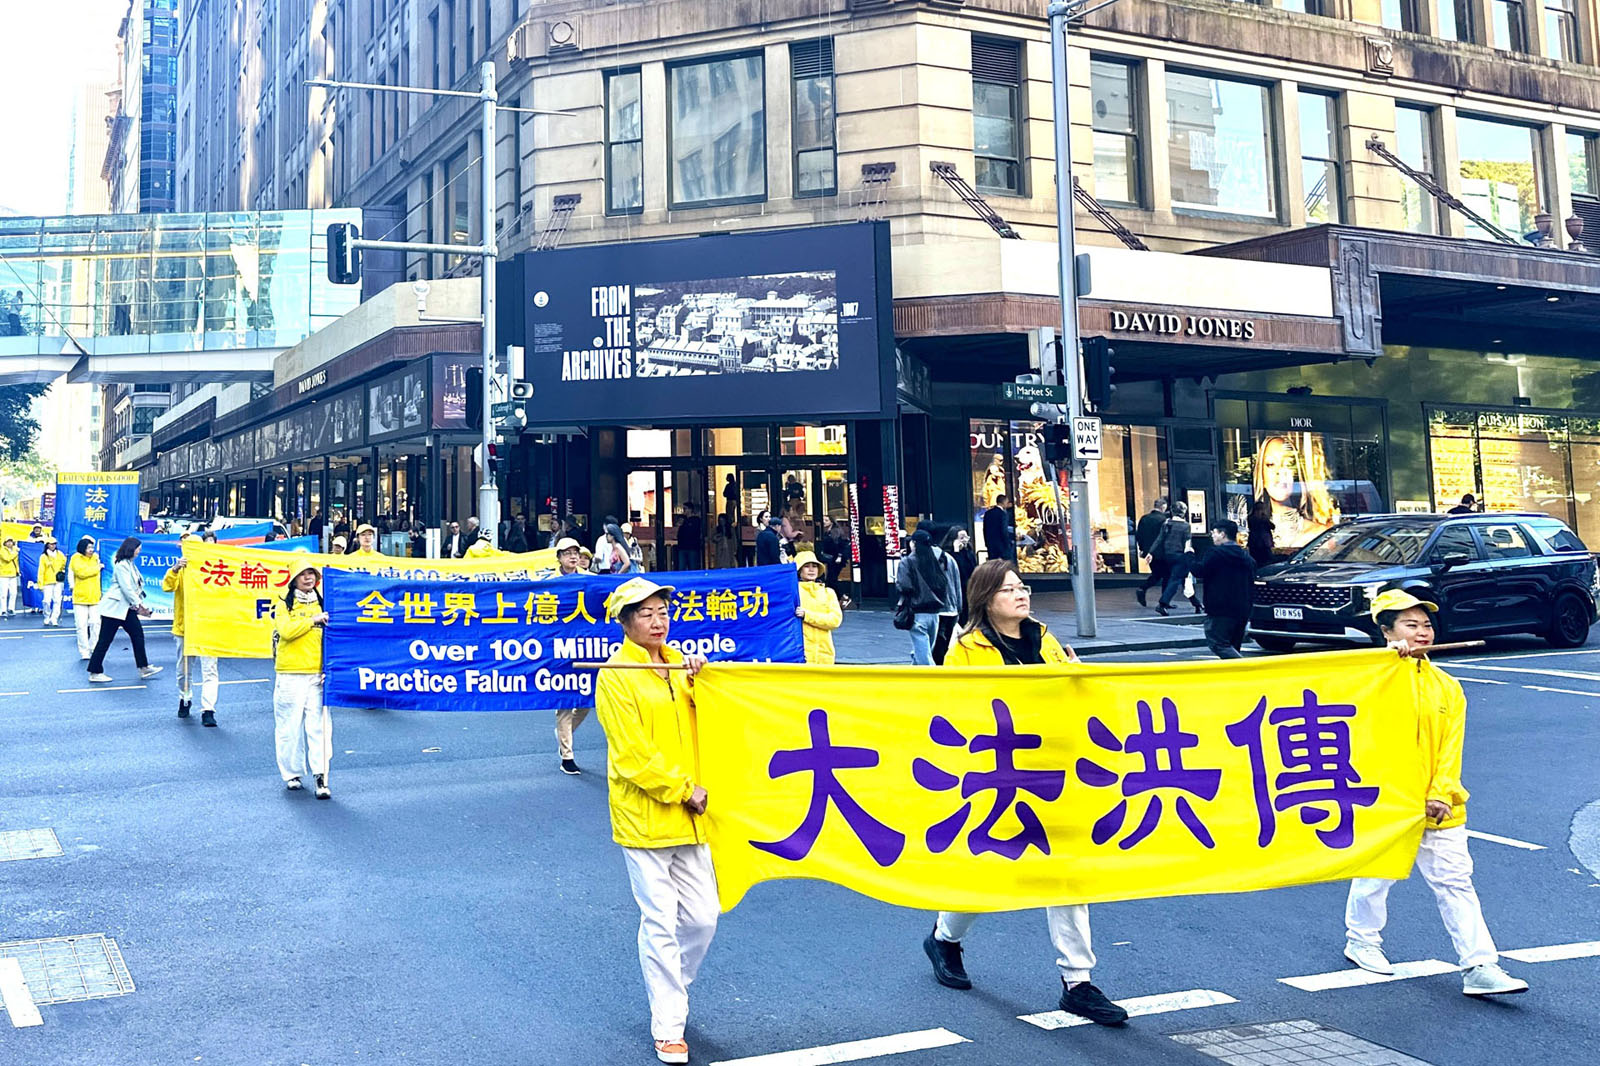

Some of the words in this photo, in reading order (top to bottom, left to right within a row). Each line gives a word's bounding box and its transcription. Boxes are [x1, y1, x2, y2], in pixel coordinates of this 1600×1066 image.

[591, 285, 630, 317] FROM
[605, 317, 631, 347] THE
[1113, 311, 1182, 333] DAVID
[1188, 316, 1255, 339] JONES
[561, 348, 632, 382] ARCHIVES
[1016, 386, 1044, 397] Market
[1045, 389, 1053, 397] St
[1077, 421, 1097, 432] ONE
[1290, 417, 1313, 428] DIOR
[1077, 434, 1098, 444] WAY
[84, 487, 109, 529] 法輪
[356, 586, 770, 627] 全世界上億人法輪功
[408, 638, 479, 662] Over
[489, 638, 543, 661] 100
[553, 637, 623, 659] Millio
[666, 633, 736, 658] eople
[358, 667, 458, 694] Practice
[465, 669, 528, 694] Falun
[534, 668, 592, 696] Gong
[749, 689, 1380, 867] 大法洪傳
